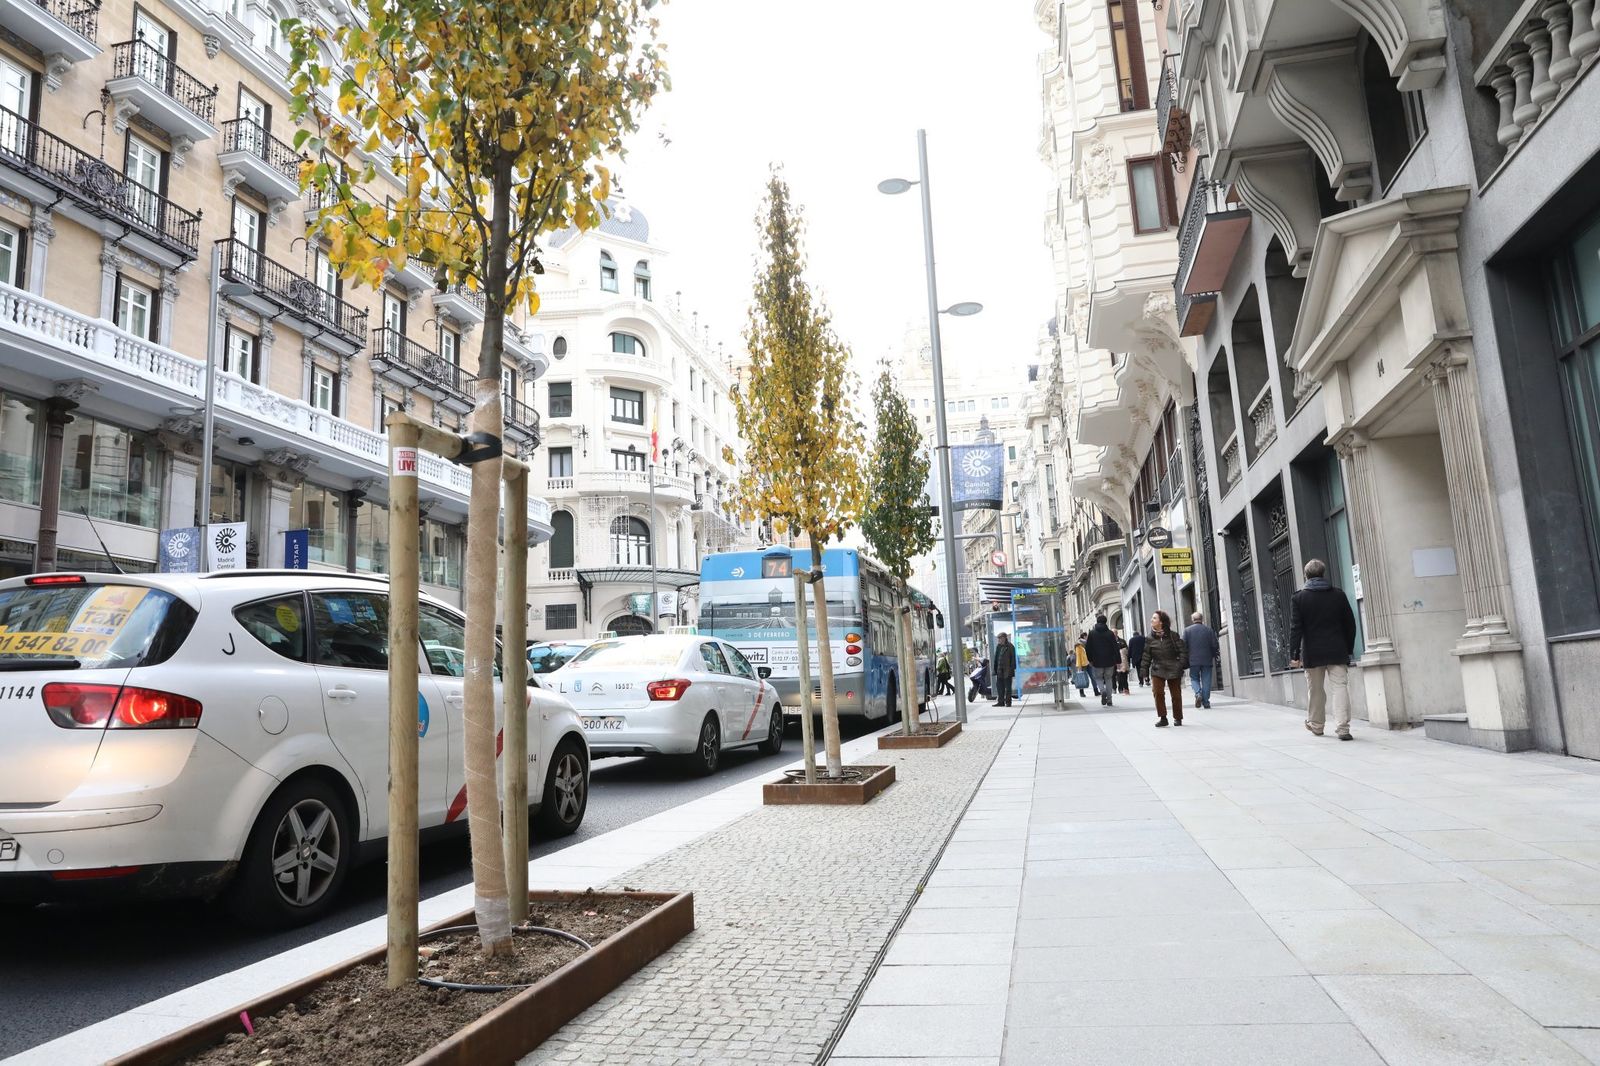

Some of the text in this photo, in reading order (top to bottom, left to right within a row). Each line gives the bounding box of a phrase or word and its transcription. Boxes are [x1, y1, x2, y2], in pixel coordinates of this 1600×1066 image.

[399, 460, 416, 471] LIVE
[768, 561, 788, 577] 74
[15, 636, 52, 651] 547
[52, 637, 79, 652] 82
[81, 638, 108, 654] 00
[745, 651, 765, 661] witz
[582, 720, 622, 729] 500 KKZ
